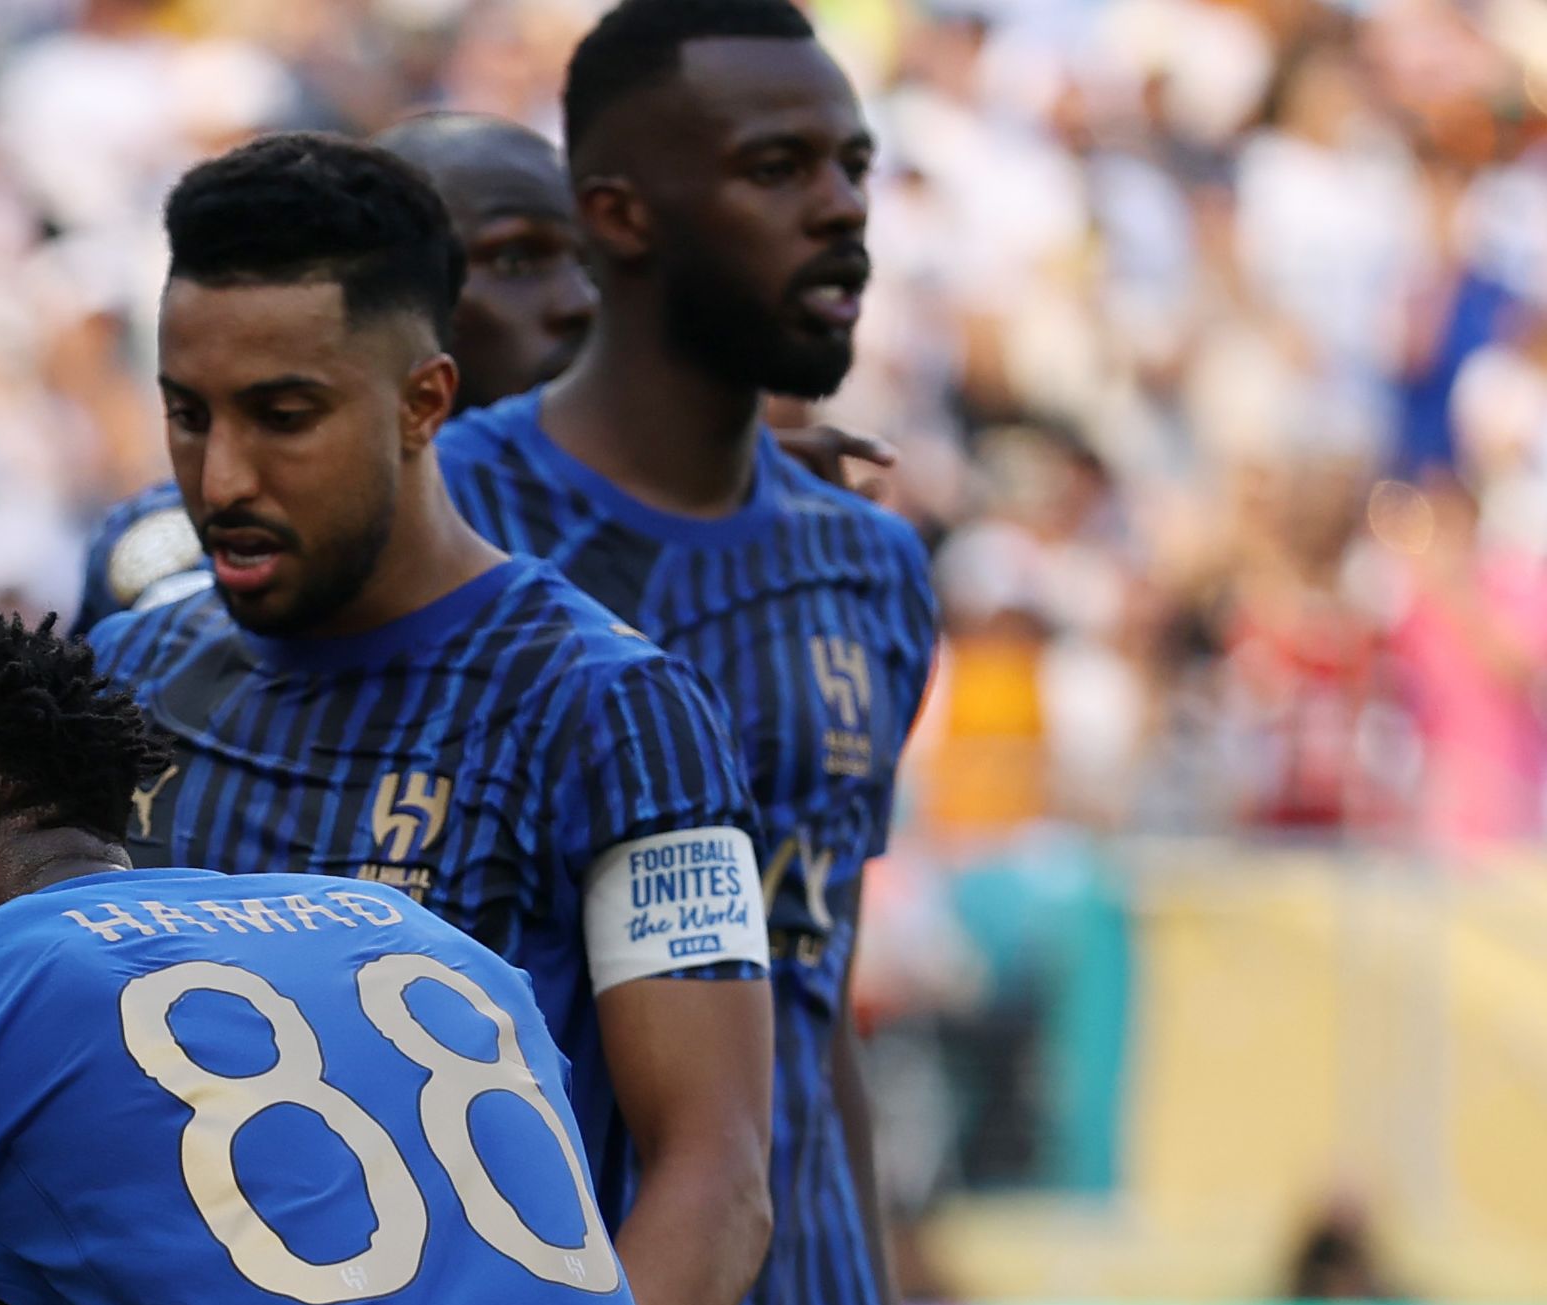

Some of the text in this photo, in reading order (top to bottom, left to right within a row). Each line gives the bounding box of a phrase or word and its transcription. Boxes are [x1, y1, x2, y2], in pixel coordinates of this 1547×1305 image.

[629, 840, 736, 875] FOOTBALL
[632, 865, 741, 909] UNITES
[61, 891, 403, 942] HAMAD
[625, 898, 748, 942] the World
